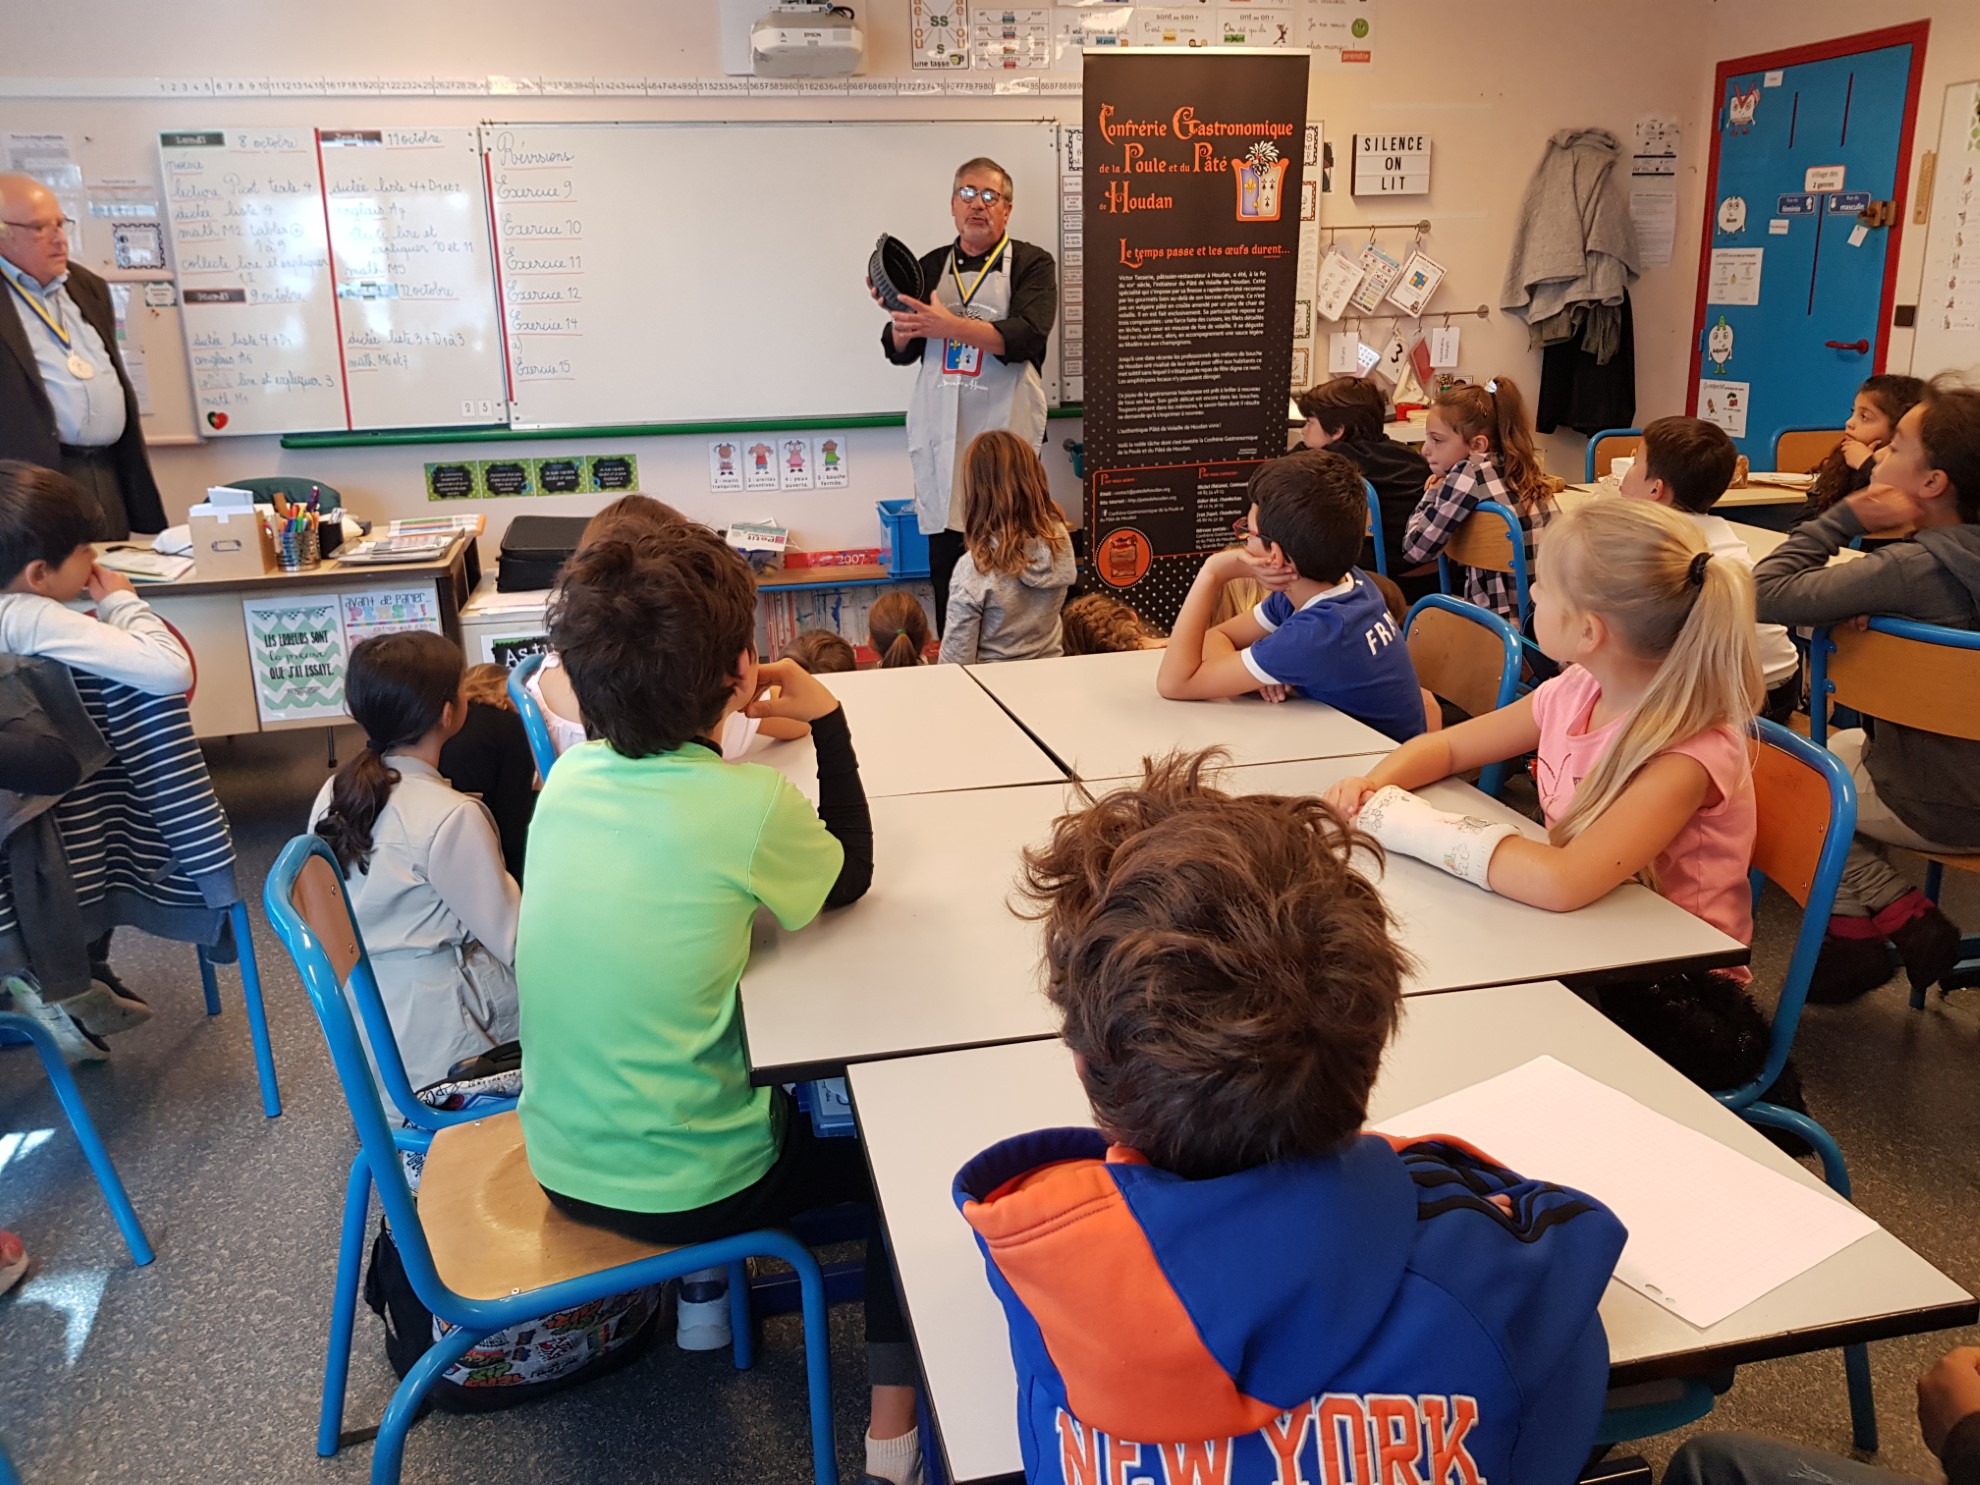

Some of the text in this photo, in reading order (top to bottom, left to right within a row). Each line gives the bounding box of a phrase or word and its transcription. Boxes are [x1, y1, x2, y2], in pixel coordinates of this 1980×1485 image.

[1343, 52, 1369, 61] prendre
[1099, 103, 1293, 145] Confrérie Gastronomique
[253, 134, 298, 149] octobre
[401, 130, 441, 144] octobre
[1364, 136, 1423, 152] SILENCE
[1099, 142, 1227, 174] de la Poule et du Pâté
[1385, 157, 1401, 171] ON
[494, 174, 572, 199] Exercice 9
[1381, 176, 1406, 191] LIT
[1105, 180, 1173, 214] Houdan
[178, 224, 220, 238] math
[501, 213, 582, 236] Exercice 10
[504, 247, 581, 270] Exercice 11
[1135, 246, 1164, 264] temps
[1166, 246, 1194, 259] passe
[1196, 246, 1206, 256] et
[1209, 245, 1223, 256] les
[1225, 245, 1249, 256] œufs
[506, 280, 582, 302] Exercice 12
[510, 309, 578, 330] Exercice 14
[559, 360, 570, 373] 15
[838, 554, 866, 565] 2007
[345, 595, 374, 608] avant
[380, 594, 392, 605] de
[264, 630, 328, 648] LES ERREURS SONT
[270, 665, 285, 680] QUE
[288, 664, 303, 679] J'AI
[1055, 1391, 1487, 1485] NEW YORK
